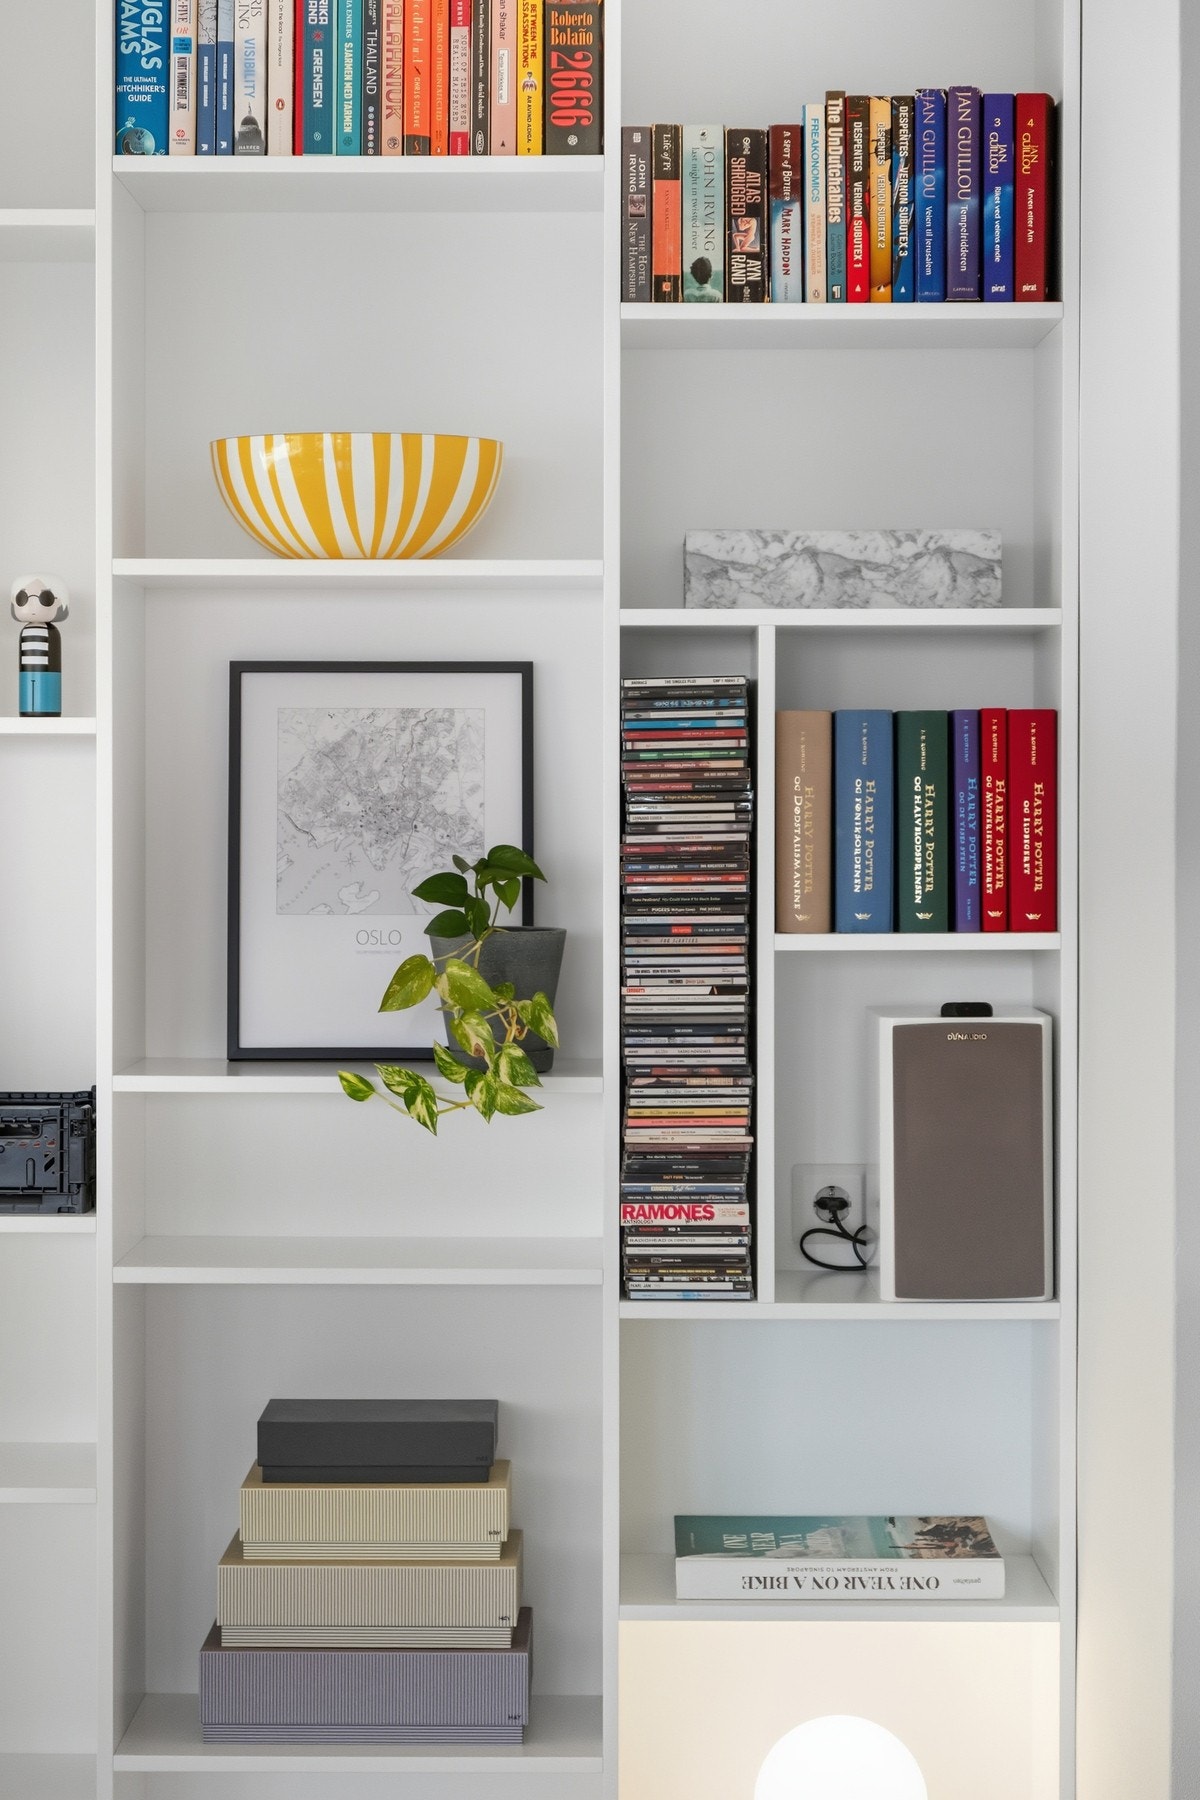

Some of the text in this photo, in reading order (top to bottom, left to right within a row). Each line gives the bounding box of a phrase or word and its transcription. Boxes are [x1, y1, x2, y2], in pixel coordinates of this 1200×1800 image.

[121, 0, 140, 54] AMS
[551, 11, 592, 26] Roberto
[551, 28, 593, 45] Bolaño
[177, 57, 187, 70] KURT
[244, 38, 255, 98] VISIBILITY
[344, 42, 352, 80] SJARMEN
[366, 30, 377, 94] THAILAND
[386, 0, 401, 119] ALAHNIUK
[437, 44, 442, 56] OF
[461, 62, 467, 73] OF
[313, 49, 322, 107] GRENSEN
[344, 82, 352, 99] MED
[551, 51, 593, 126] 2666
[344, 100, 352, 132] TARMEN
[899, 106, 908, 157] DESPENTES
[994, 118, 1001, 127] 3
[1027, 119, 1034, 127] 4
[663, 134, 671, 151] Life
[811, 118, 820, 203] FREAKONOMICS
[854, 122, 862, 171] DESPENTES
[921, 96, 936, 198] JAN GUILLOU
[955, 92, 971, 200] JAN GUILLOU
[990, 132, 998, 174] GUILLOU
[998, 144, 1007, 162] JAN
[1022, 133, 1030, 174] GUILLOU
[1030, 145, 1038, 163] JAN
[663, 162, 671, 170] Pi
[689, 163, 699, 185] night
[782, 160, 792, 169] of
[829, 98, 843, 224] The UnDutchables
[701, 146, 715, 251] JOHN IRVING
[731, 157, 746, 215] SHRUGGED
[746, 171, 761, 203] ATLAS
[854, 181, 862, 217] VERNON
[899, 167, 908, 204] VERNON
[781, 208, 793, 276] MARK HADDON
[854, 220, 862, 261] SUBUTEX
[899, 206, 908, 248] SUBUTEX
[959, 205, 969, 271] Tempelridderen
[629, 247, 637, 298] HAMPSHIRE
[638, 255, 647, 284] HOTEL
[731, 254, 746, 285] RAND
[746, 259, 761, 281] AYN
[991, 284, 1005, 293] pirat
[1022, 284, 1036, 292] pirat
[855, 779, 862, 794] OG
[914, 776, 921, 793] OG
[959, 792, 965, 804] OG
[986, 775, 992, 788] OG
[1023, 800, 1030, 813] OG
[794, 776, 802, 910] OG DØDSTALISMANENE
[804, 786, 813, 894] HARRY POTTER
[864, 780, 876, 891] HARRY POTTER
[924, 784, 935, 892] HARRY POTTER
[967, 778, 977, 886] HARRY POTTER
[995, 780, 1005, 889] HARRY POTTER
[1034, 782, 1044, 892] HARRY POTTER
[356, 930, 401, 945] OSLO
[623, 1205, 715, 1219] RAMONES
[742, 1576, 940, 1590] ONE YEAR ON A BIKE
